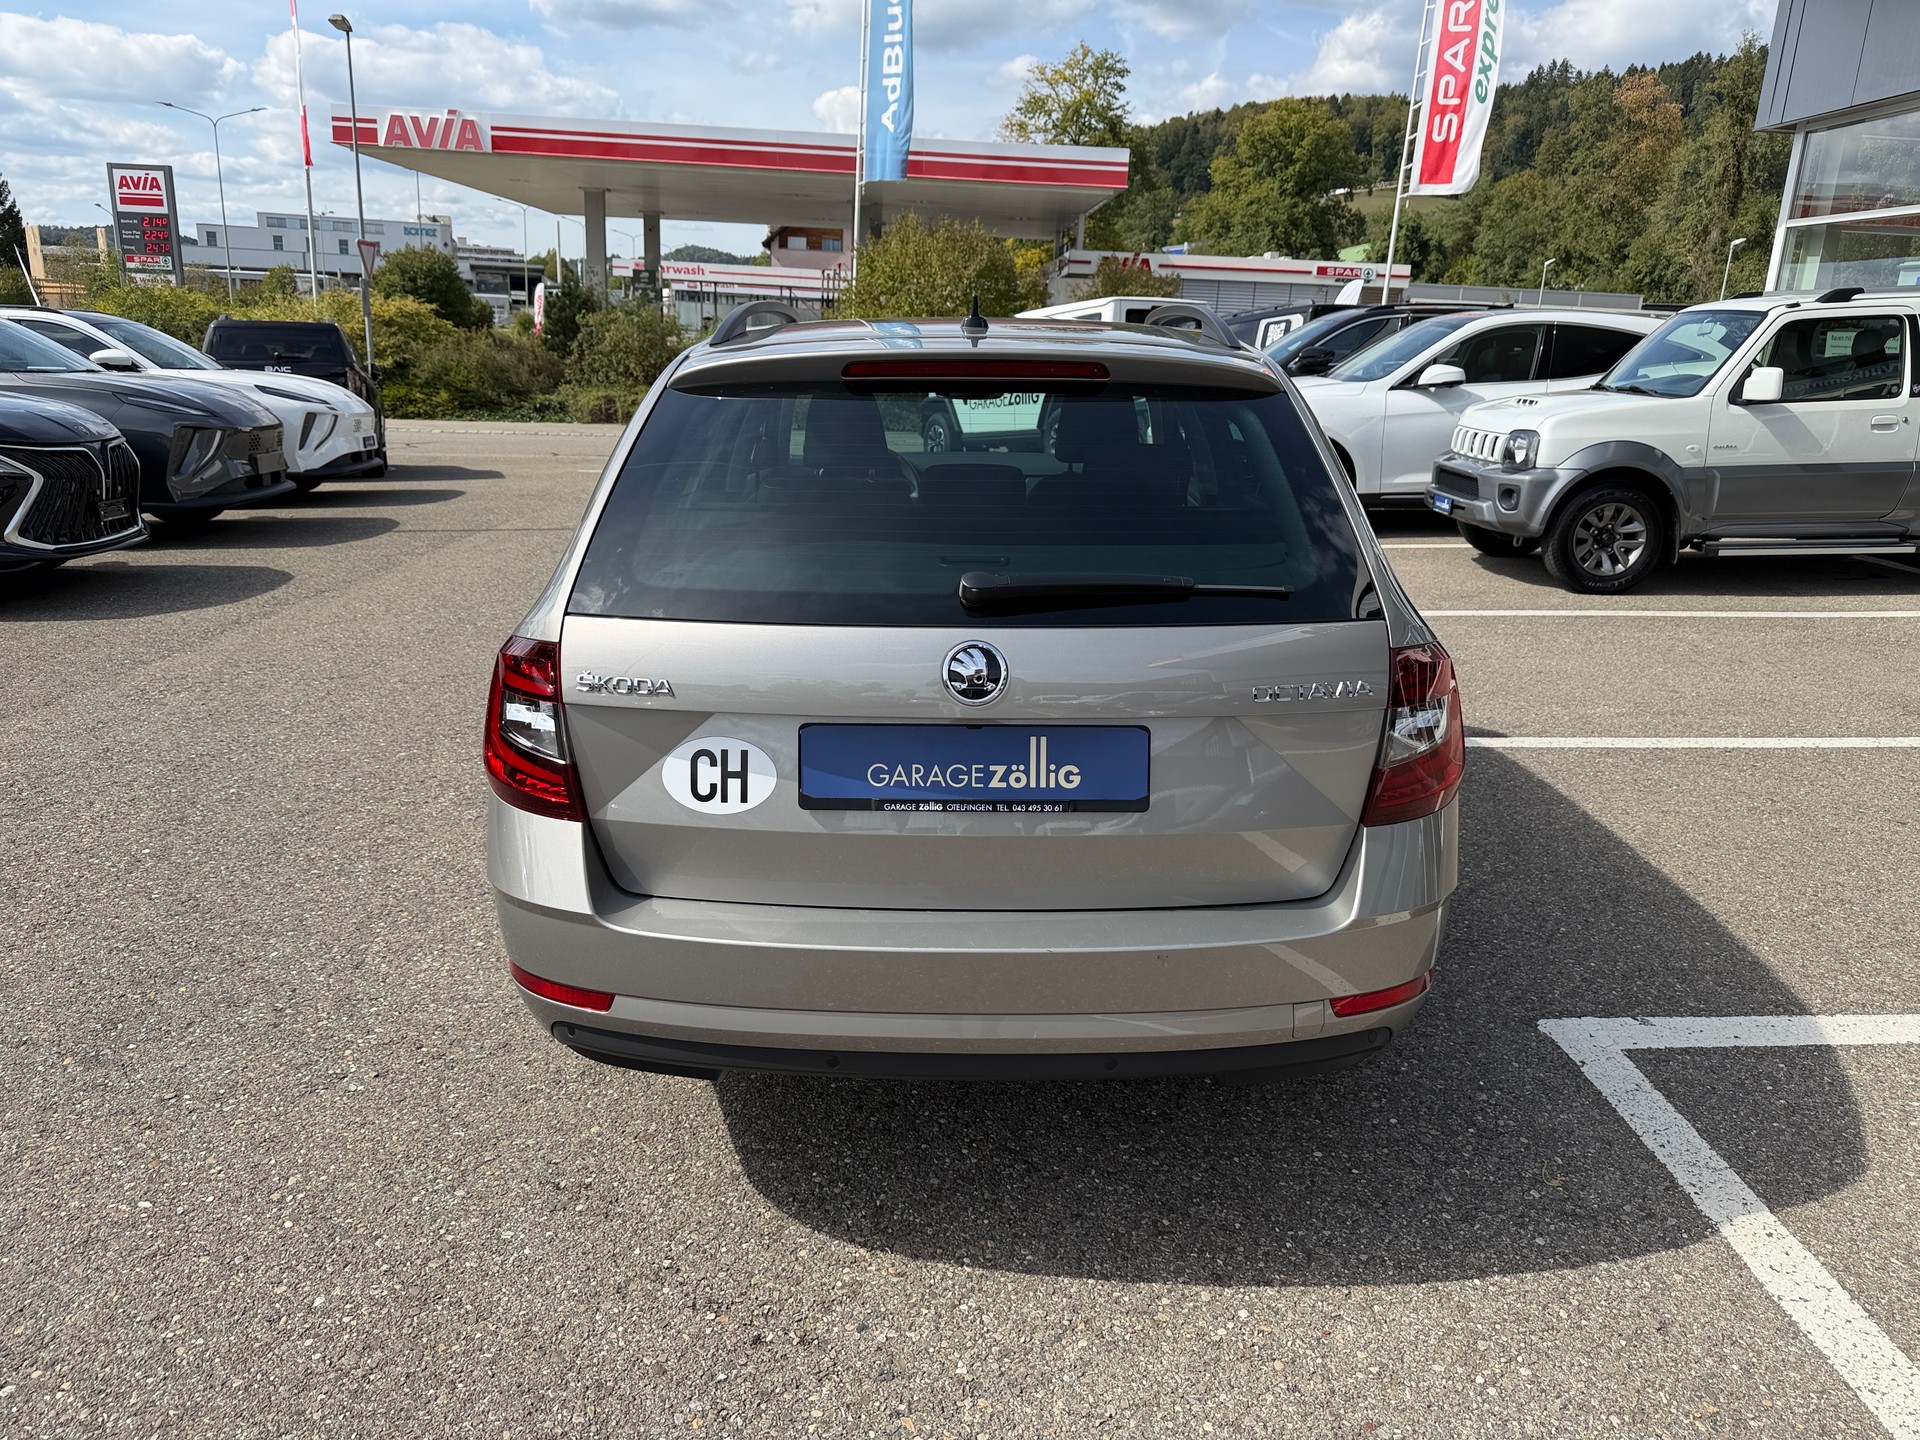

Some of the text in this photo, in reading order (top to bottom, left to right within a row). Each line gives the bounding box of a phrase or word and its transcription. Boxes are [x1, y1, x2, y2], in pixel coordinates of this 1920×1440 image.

[1431, 0, 1475, 143] SPAR
[660, 265, 705, 276] arwash
[1101, 252, 1152, 274] iA
[1326, 267, 1362, 277] SPAR
[575, 670, 676, 699] ŠKODA
[1252, 680, 1374, 702] OCTAVIA
[690, 748, 749, 804] CH
[867, 763, 985, 788] GARAGE
[884, 803, 917, 811] GARAGE
[946, 803, 993, 812] OTELFINGEN
[996, 804, 1010, 812] TEL.
[1012, 804, 1026, 812] 043
[1028, 804, 1041, 812] 495
[1043, 804, 1053, 812] 30
[1054, 804, 1063, 812] 61
